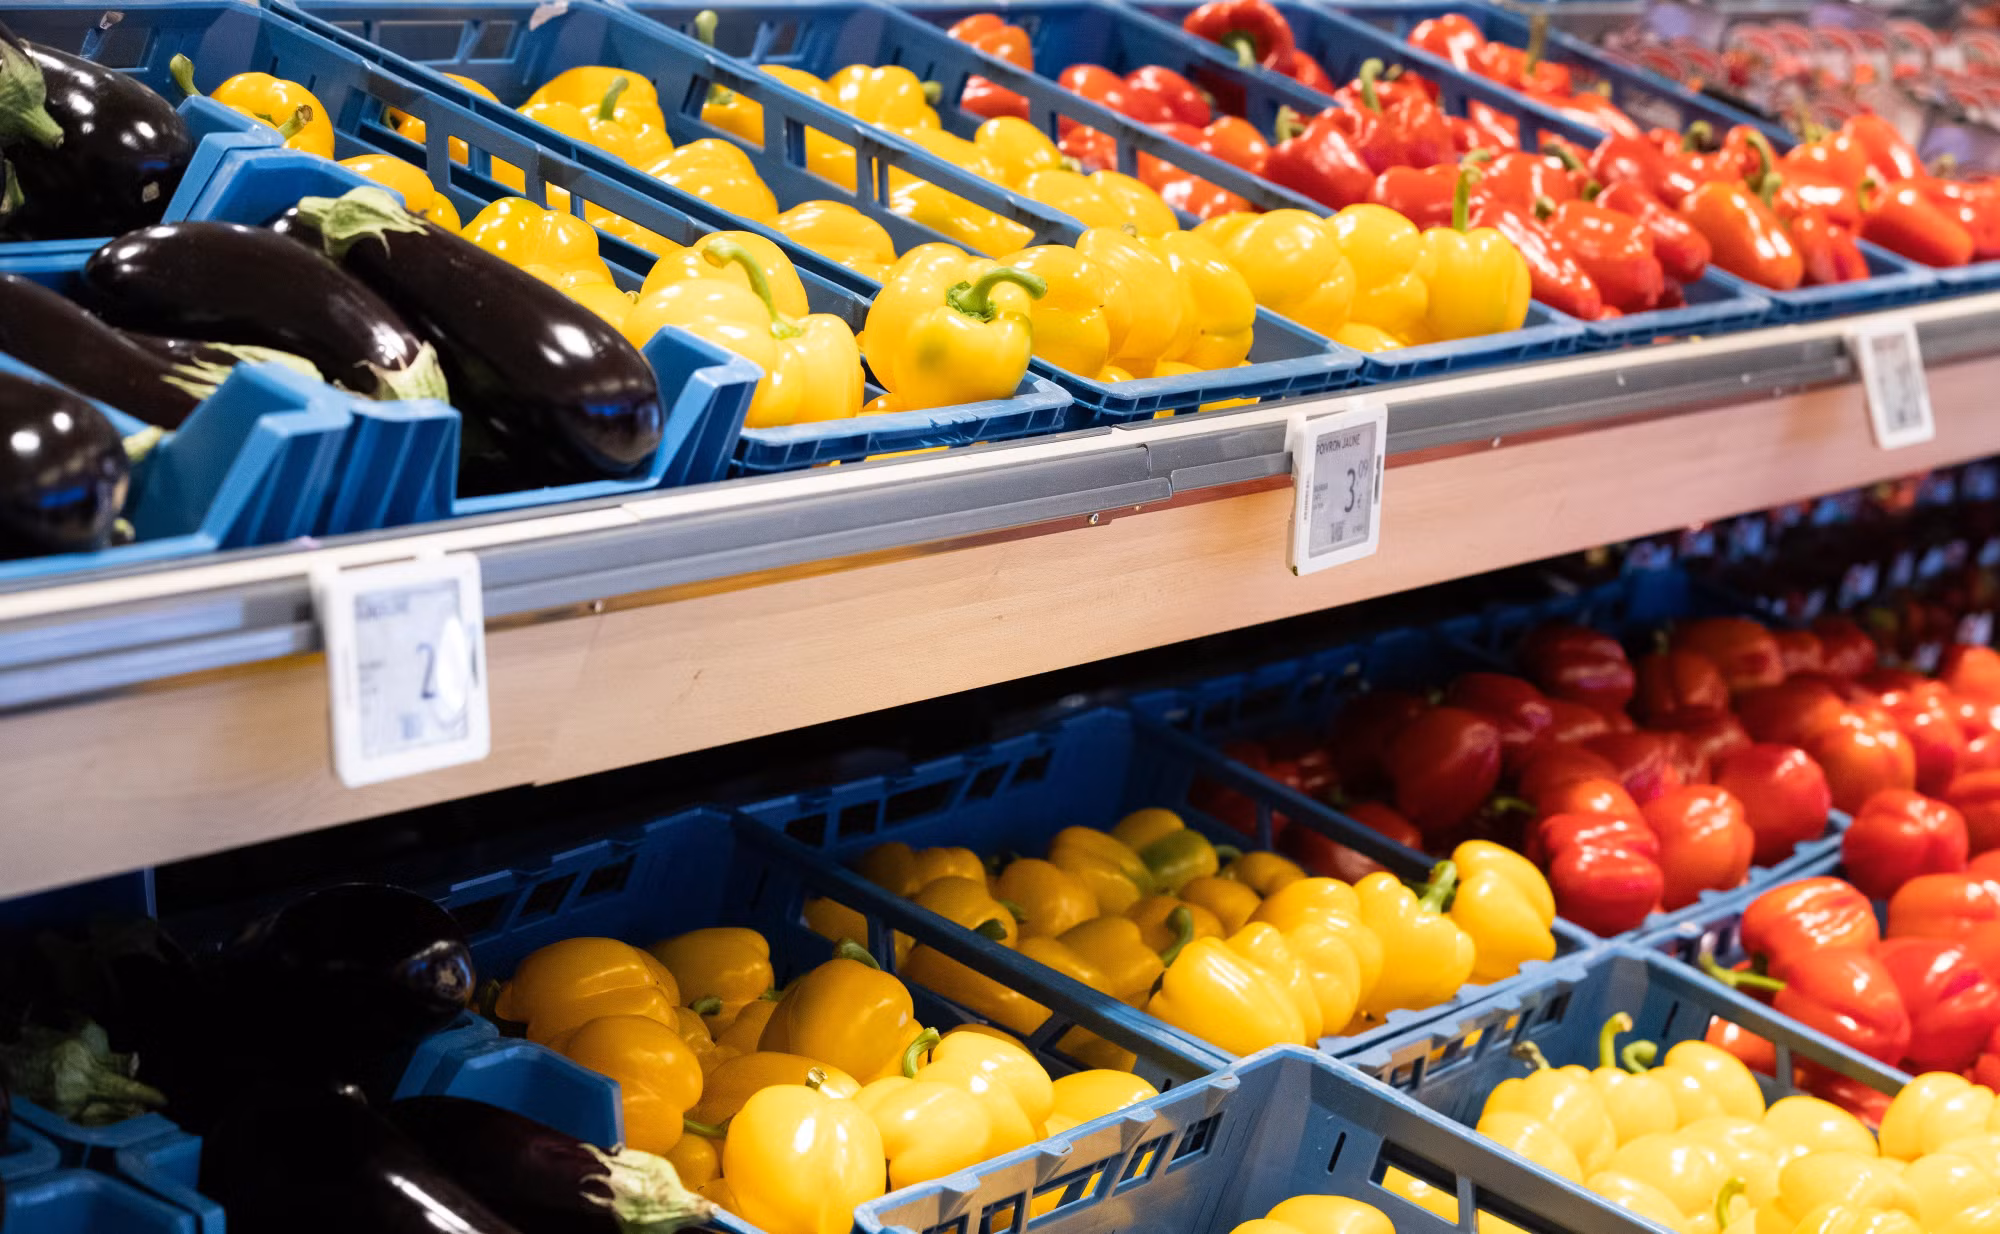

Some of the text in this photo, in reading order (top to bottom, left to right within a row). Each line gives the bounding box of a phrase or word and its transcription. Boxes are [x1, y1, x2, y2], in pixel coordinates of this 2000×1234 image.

[1316, 433, 1361, 455] POIVRON JAUNE
[1344, 459, 1369, 513] 3 09
[416, 642, 436, 700] 2
